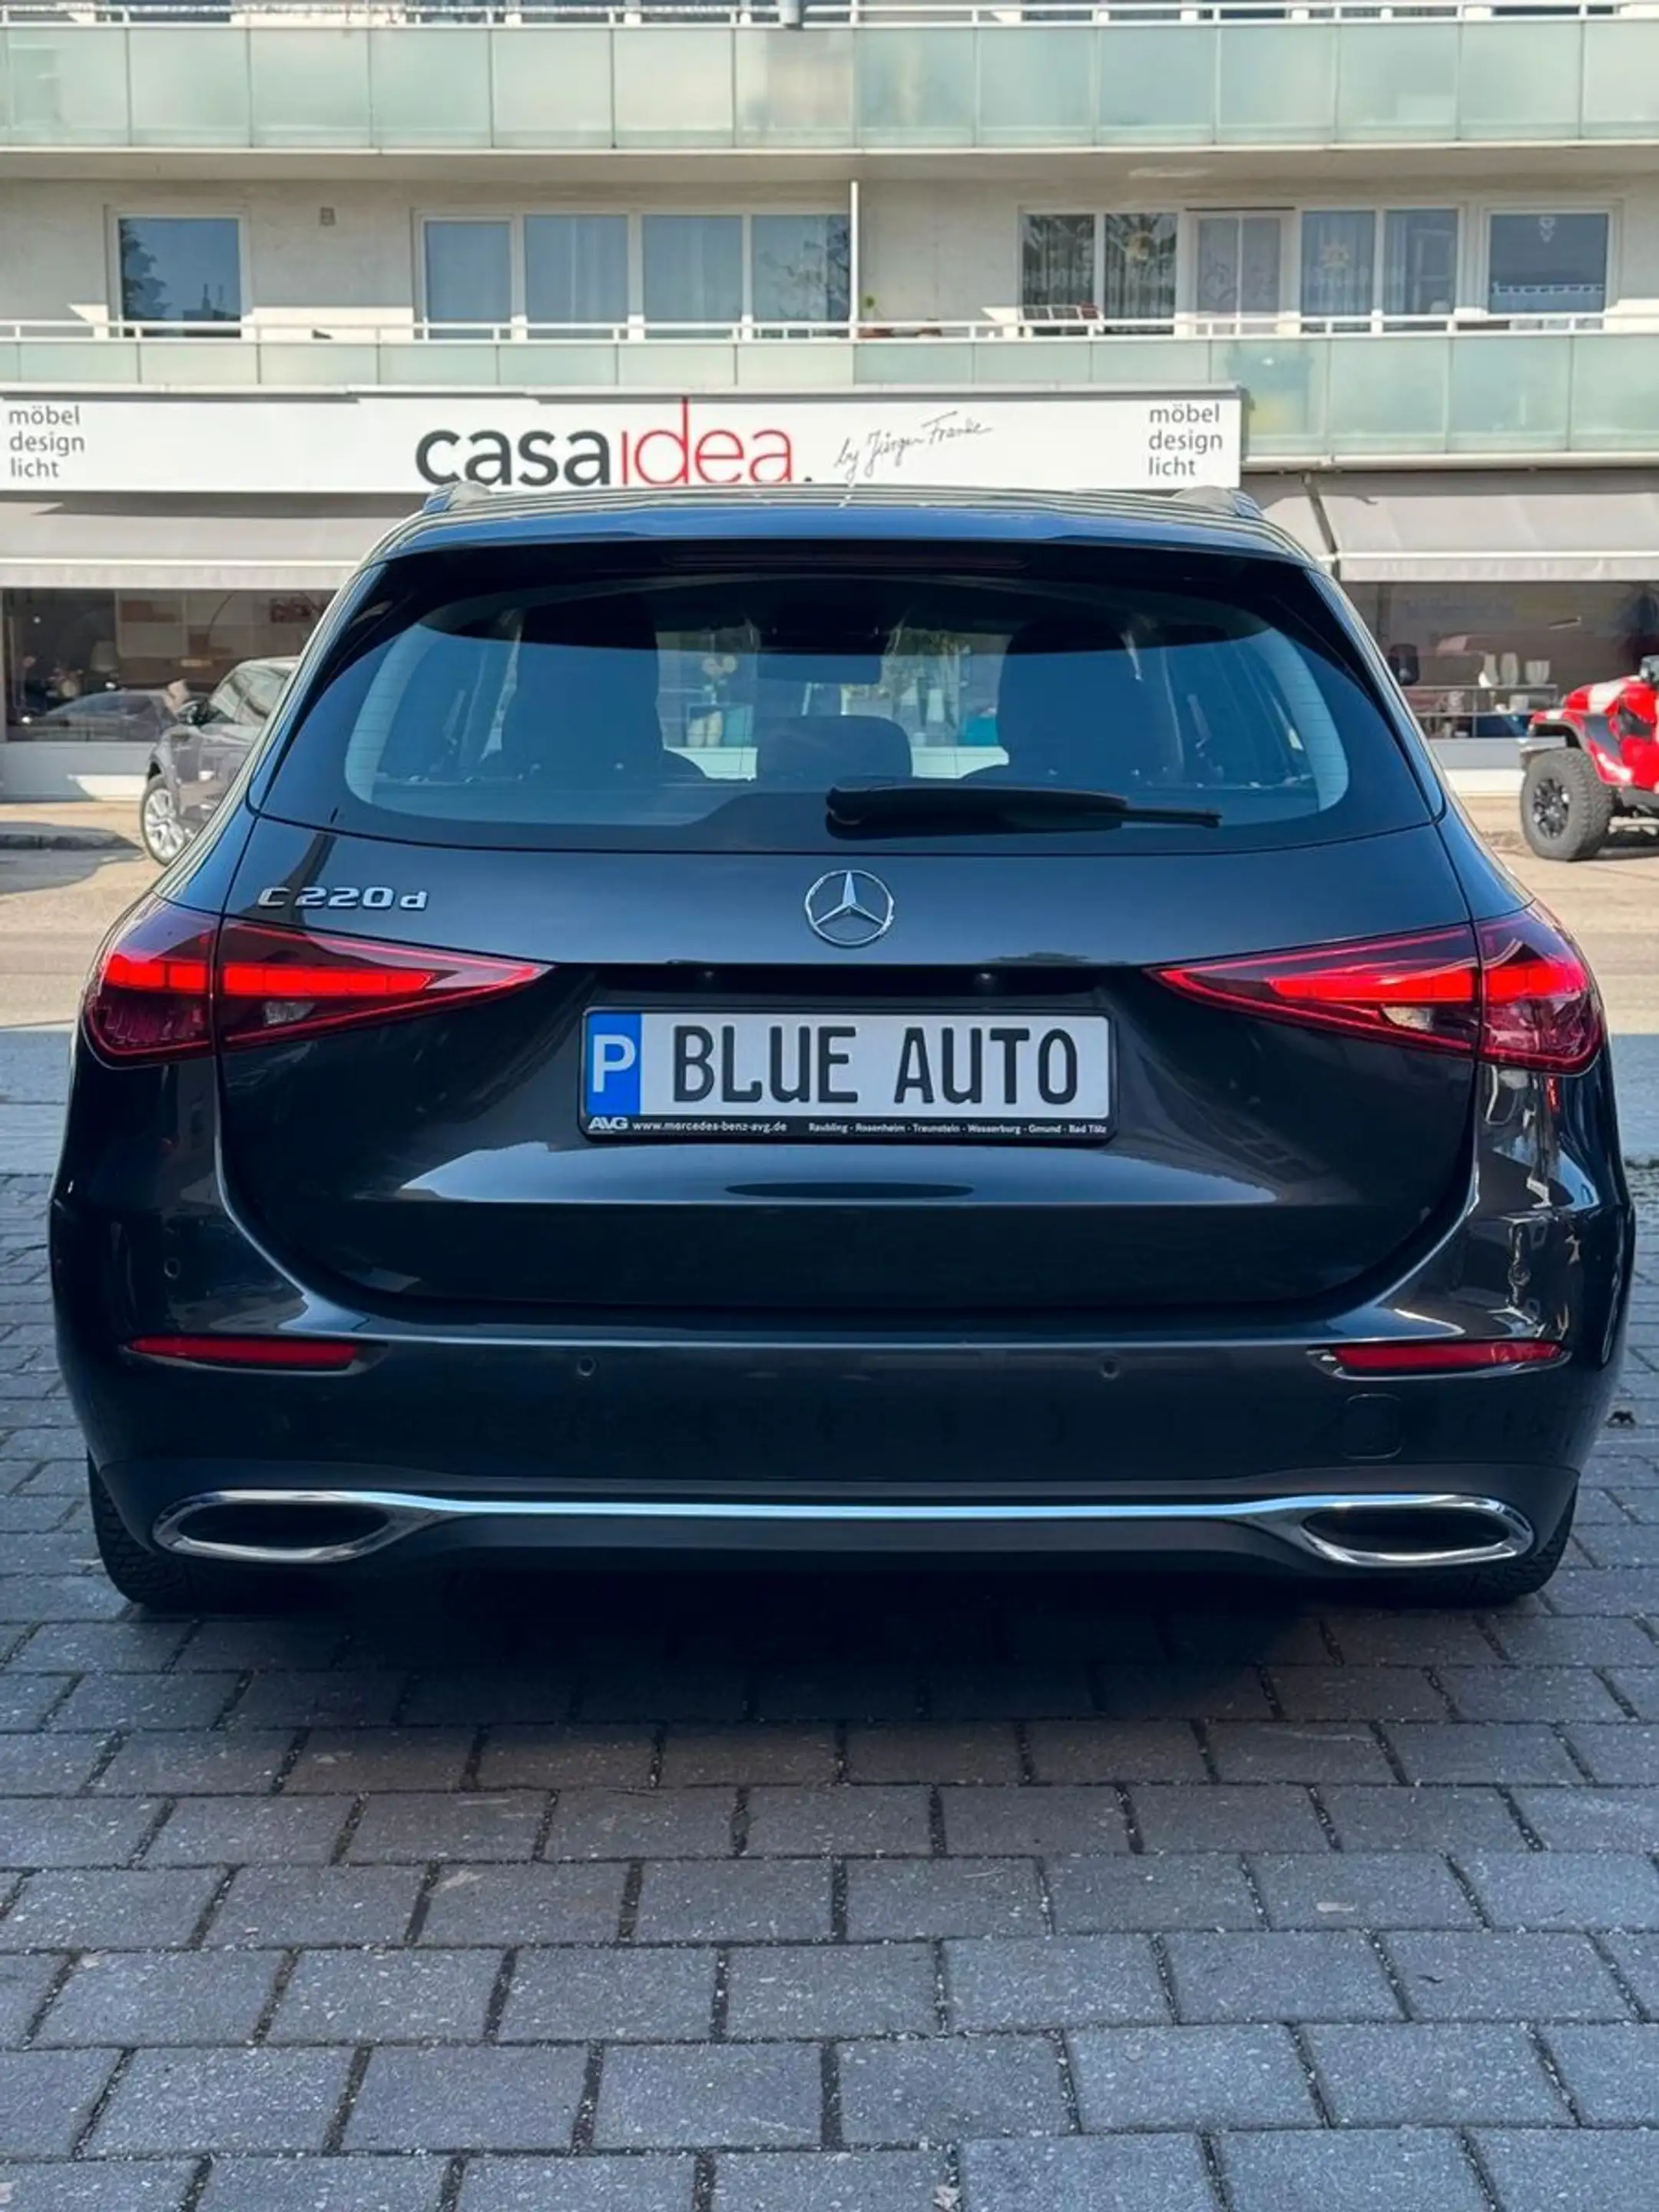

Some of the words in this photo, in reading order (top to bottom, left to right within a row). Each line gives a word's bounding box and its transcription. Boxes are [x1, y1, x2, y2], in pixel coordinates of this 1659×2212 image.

[9, 404, 81, 425] möbel
[1150, 402, 1220, 423] möbel
[9, 430, 85, 457] design
[1148, 429, 1223, 455] design
[10, 457, 59, 478] licht
[1148, 456, 1196, 476] licht
[257, 886, 290, 908] C
[593, 1034, 636, 1092] P
[673, 1025, 859, 1104] BLUE
[894, 1027, 1078, 1105] AUTO
[588, 1117, 628, 1130] AVG
[632, 1119, 787, 1134] www.mercedes-benz-avg.de
